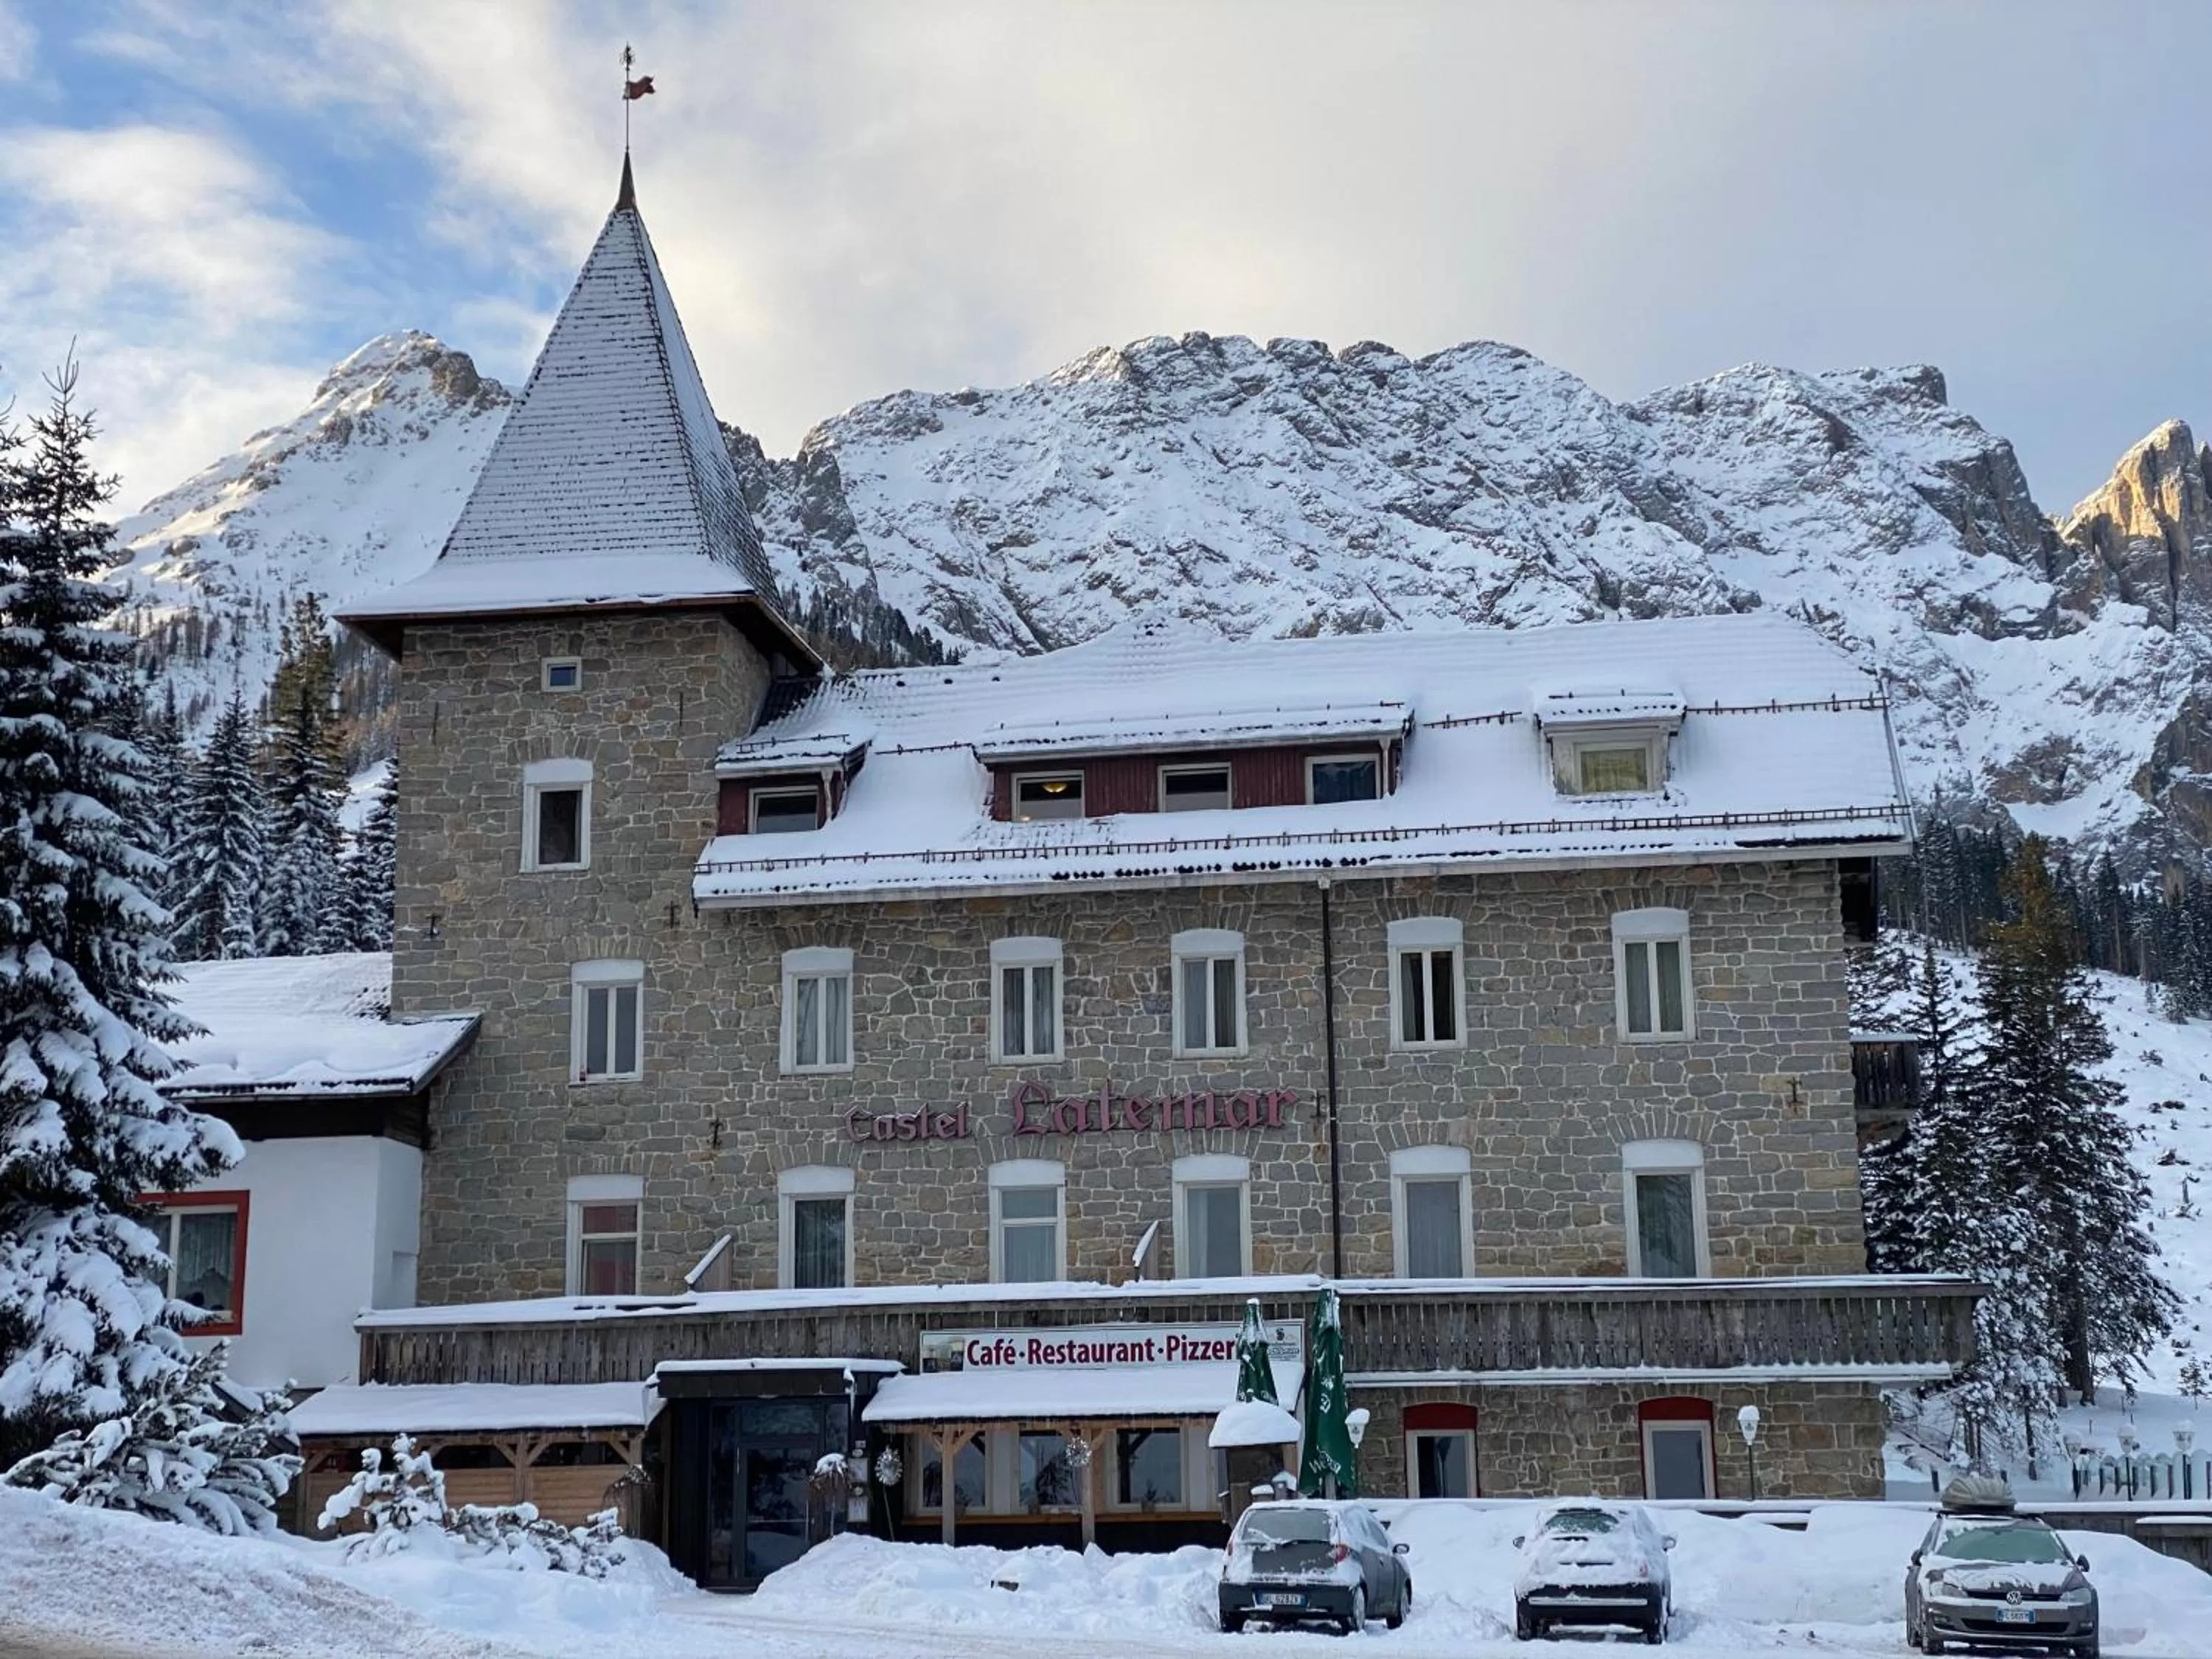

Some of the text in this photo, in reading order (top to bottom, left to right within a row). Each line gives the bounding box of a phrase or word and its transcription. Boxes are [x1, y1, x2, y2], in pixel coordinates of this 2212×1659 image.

[844, 1079, 1298, 1141] Castel Latemar
[967, 1338, 1016, 1366] Café
[1027, 1338, 1155, 1365] Restaurant
[1166, 1334, 1239, 1362] Pizzer
